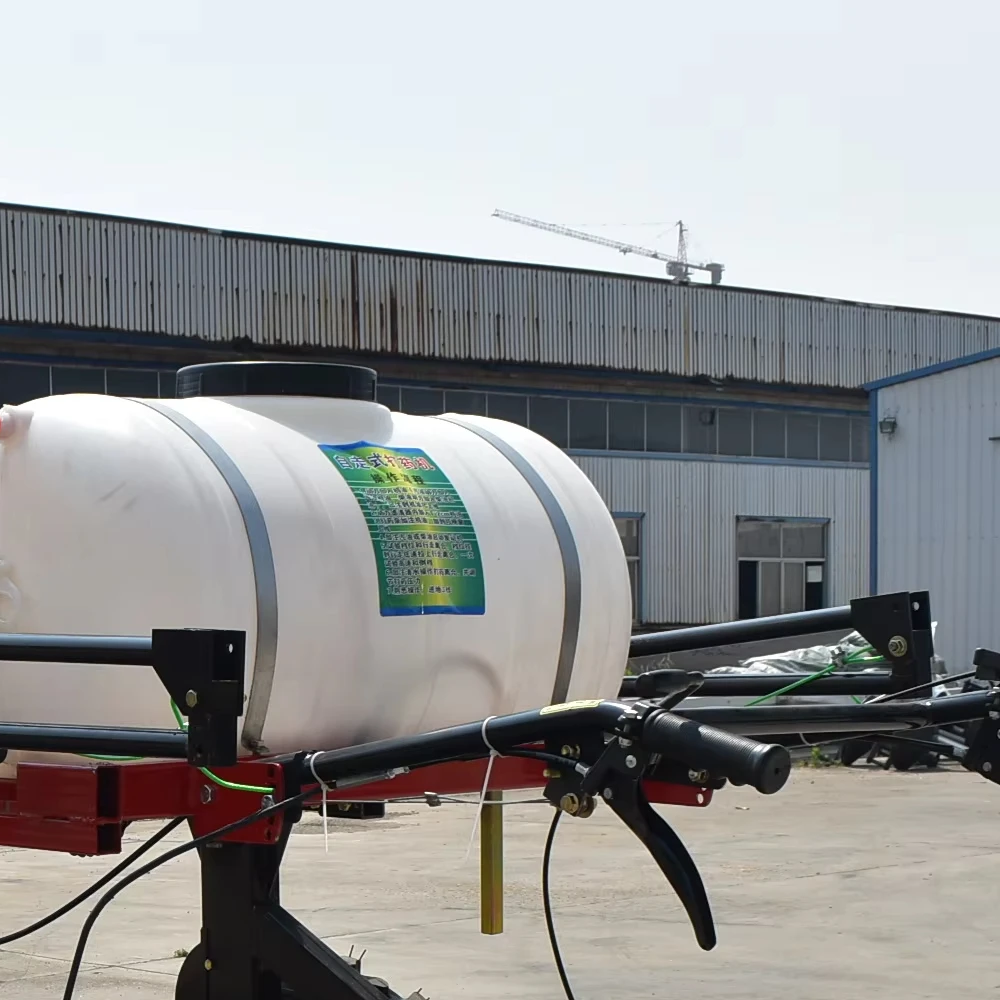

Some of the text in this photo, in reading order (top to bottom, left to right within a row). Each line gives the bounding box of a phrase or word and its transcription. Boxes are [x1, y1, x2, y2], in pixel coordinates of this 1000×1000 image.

[333, 452, 435, 471] 自走式打药机
